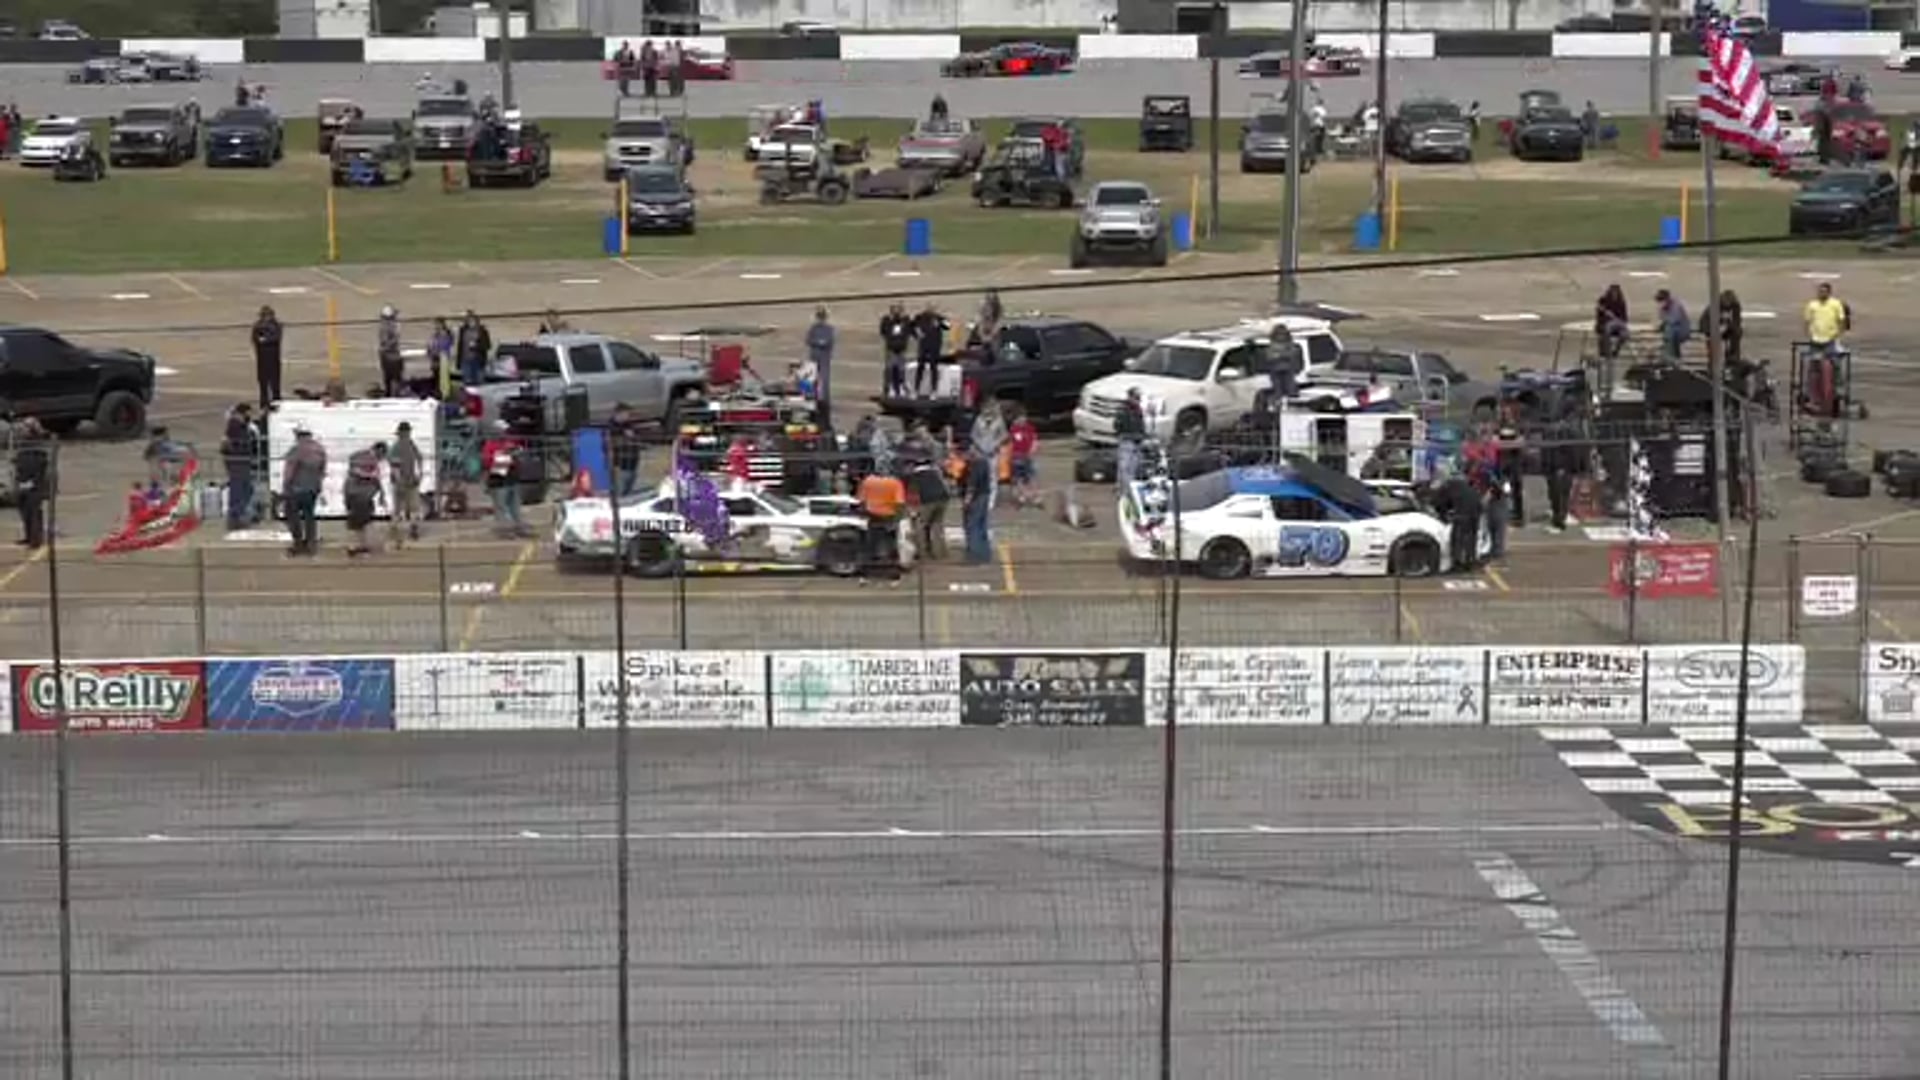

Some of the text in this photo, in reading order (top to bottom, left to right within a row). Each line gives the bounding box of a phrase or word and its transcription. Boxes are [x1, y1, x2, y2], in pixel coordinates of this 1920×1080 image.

[849, 658, 952, 675] TIMBERLINE
[1497, 651, 1641, 672] ENTERPRISE
[1879, 646, 1920, 671] Sn
[32, 671, 186, 719] O'Reilly
[597, 679, 744, 697] Whlesale
[965, 679, 1041, 697] AUTO
[1050, 679, 1139, 697] SALES
[1656, 801, 1920, 835] BO
